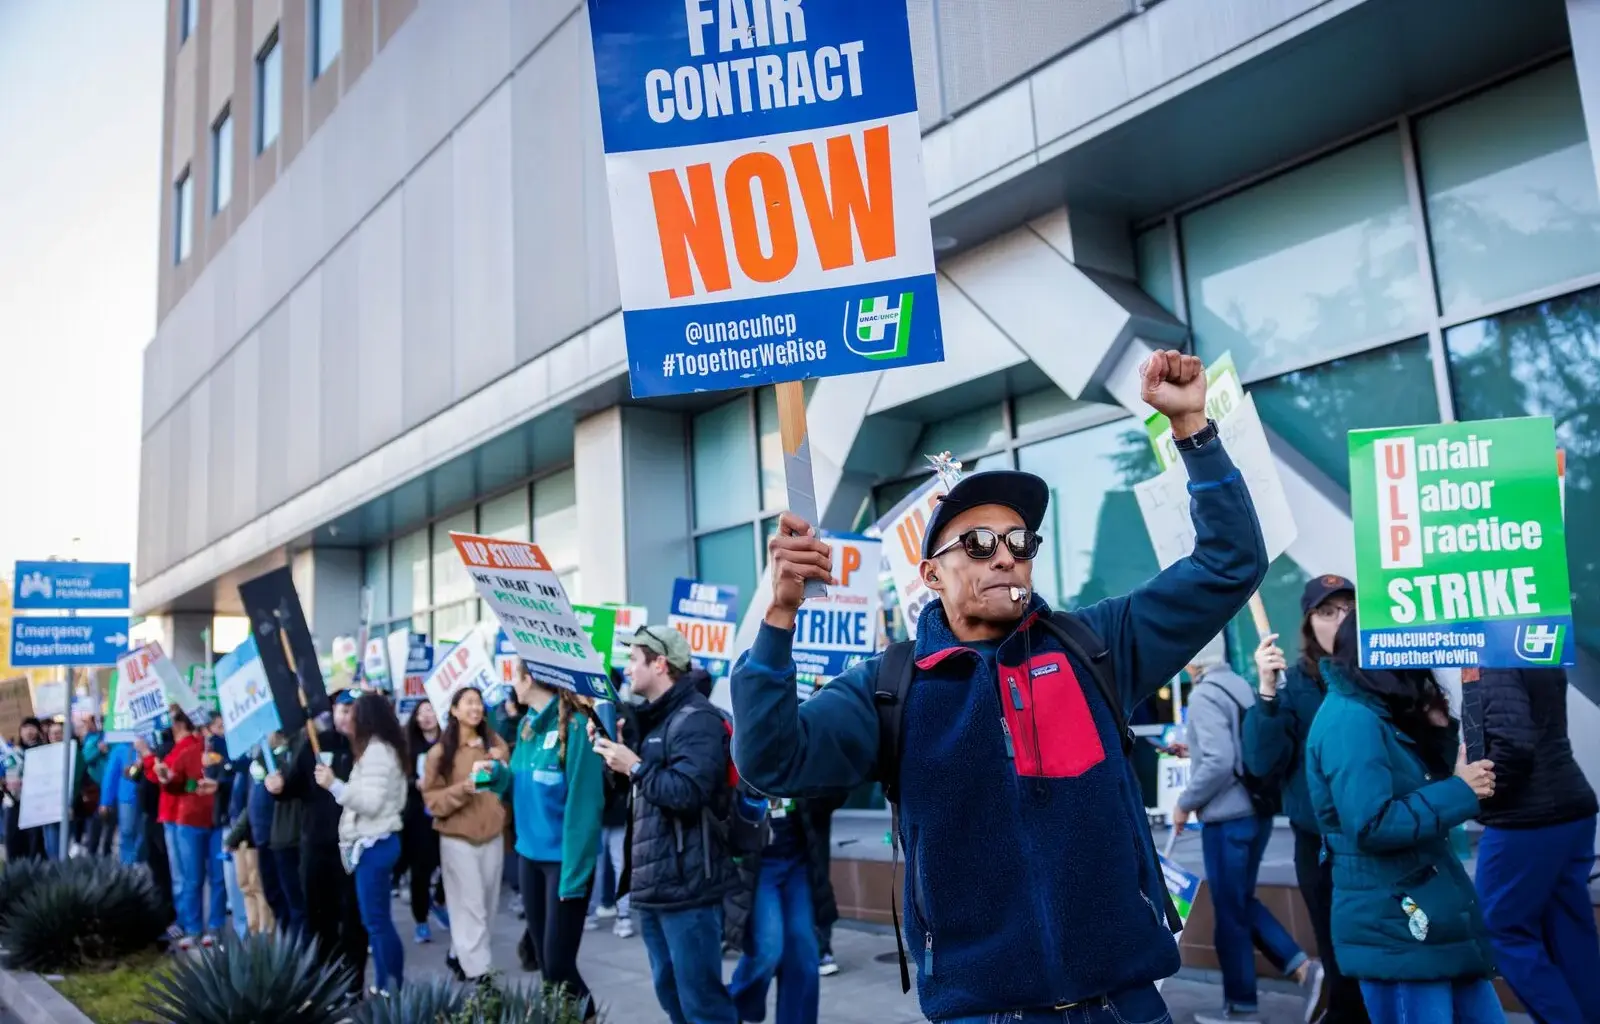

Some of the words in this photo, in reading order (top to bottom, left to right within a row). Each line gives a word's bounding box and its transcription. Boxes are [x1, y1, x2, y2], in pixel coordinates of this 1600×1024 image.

[686, 0, 806, 56] FAIR
[645, 40, 864, 124] CONTRACT
[648, 124, 896, 300] NOW
[685, 313, 797, 345] @unacuhcp
[662, 339, 827, 377] #TogetherWeRise
[461, 541, 490, 565] ULP
[488, 543, 541, 568] STRIKE
[493, 576, 531, 593] TREAT
[1388, 567, 1541, 624] STRIKE
[16, 623, 93, 640] Emergency
[796, 609, 866, 645] TRIKE
[1369, 632, 1485, 654] #UNACUHCPstrong
[15, 641, 95, 658] Department
[1370, 649, 1478, 667] #TogetherWeWin
[129, 688, 165, 720] STRIKE
[228, 685, 267, 723] thriv
